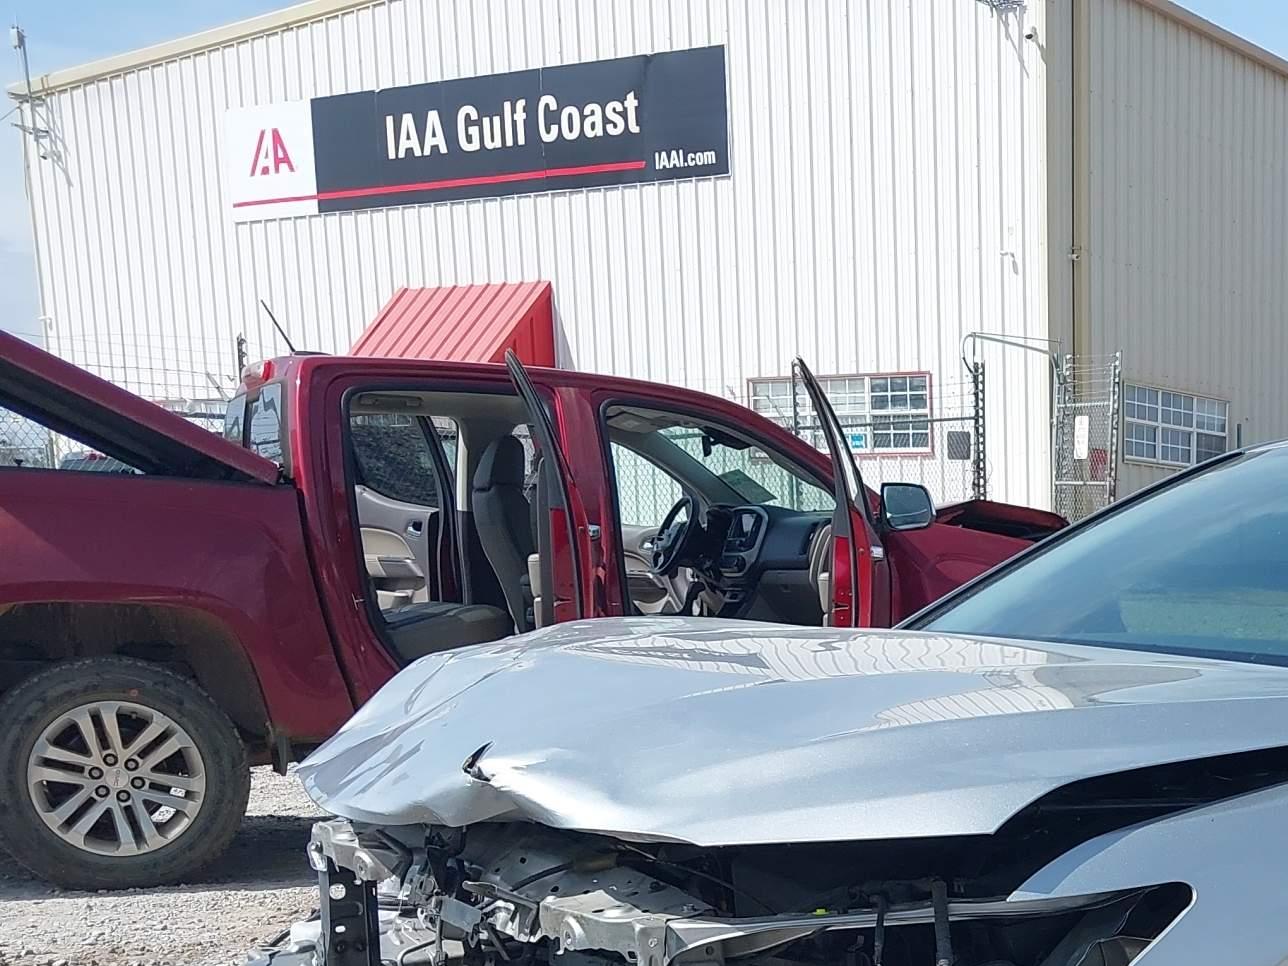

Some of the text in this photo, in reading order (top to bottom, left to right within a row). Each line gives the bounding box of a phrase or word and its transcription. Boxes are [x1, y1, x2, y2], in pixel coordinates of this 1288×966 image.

[385, 91, 640, 160] IAA Gulf Coast
[655, 150, 716, 170] IAAI.com
